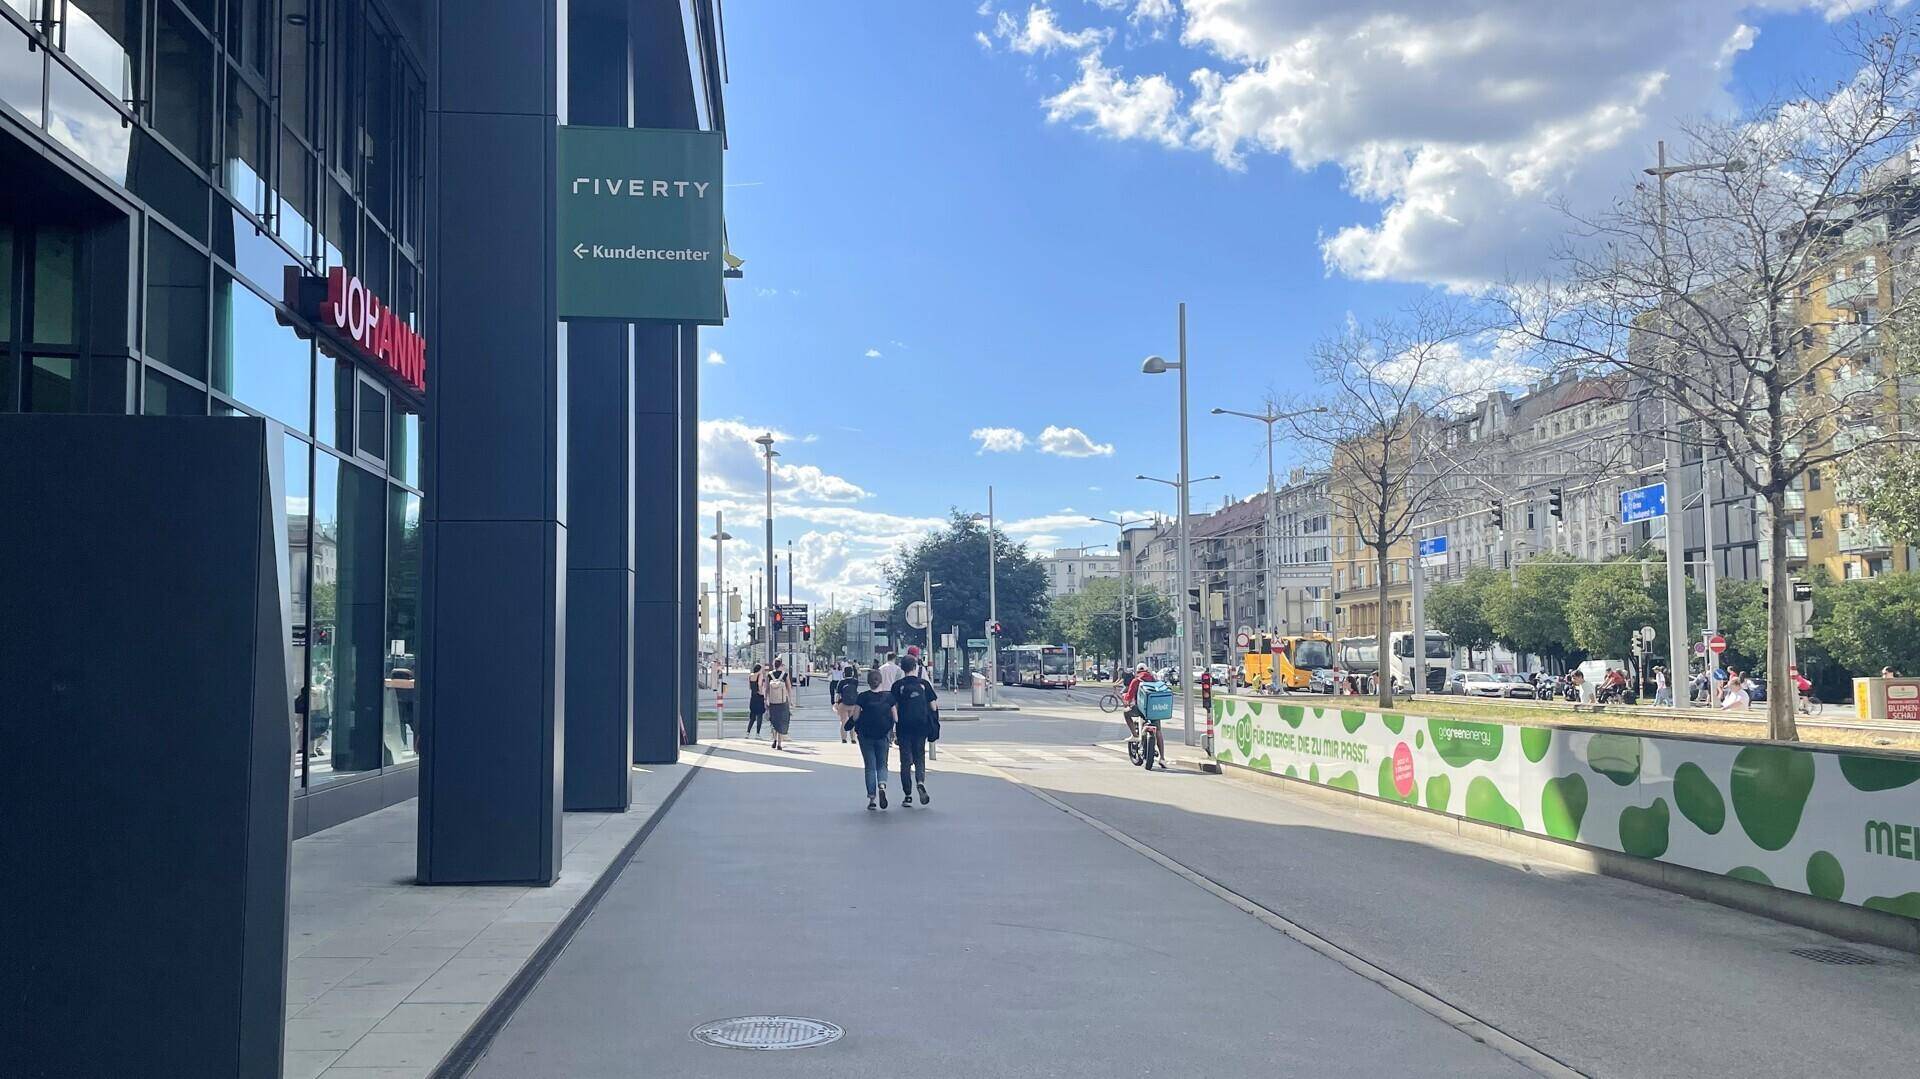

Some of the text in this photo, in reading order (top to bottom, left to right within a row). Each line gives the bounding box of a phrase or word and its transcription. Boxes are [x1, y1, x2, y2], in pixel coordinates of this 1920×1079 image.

[593, 244, 710, 261] Kundencenter
[1252, 725, 1265, 744] FÜR
[1265, 729, 1297, 753] ENERGIE,
[1298, 735, 1311, 753] DIE
[1311, 737, 1322, 756] ZU
[1323, 738, 1340, 759] MIR
[1340, 741, 1369, 764] PASST.
